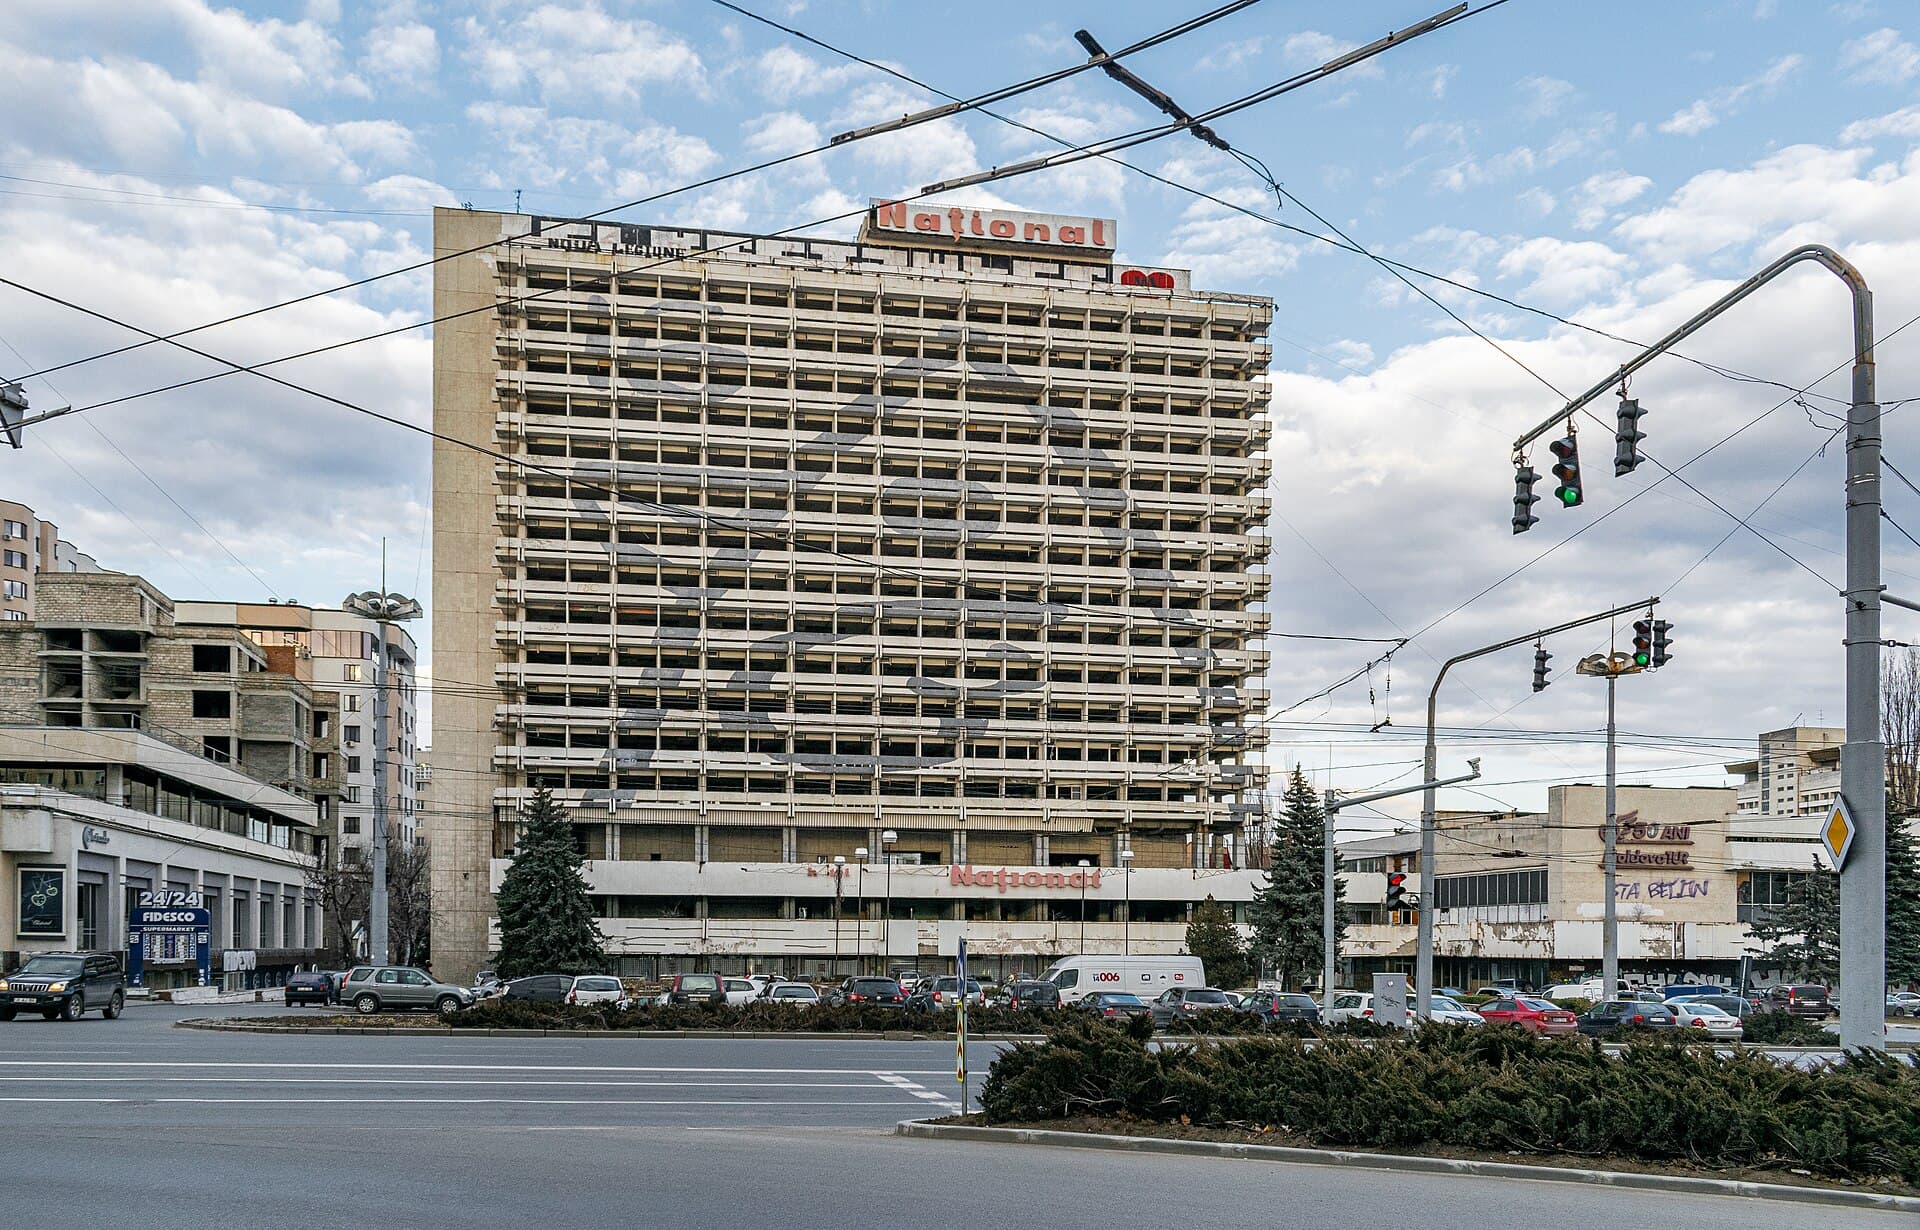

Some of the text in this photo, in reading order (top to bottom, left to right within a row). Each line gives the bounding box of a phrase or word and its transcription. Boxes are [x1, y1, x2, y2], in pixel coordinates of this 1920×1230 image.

[1660, 826, 1691, 840] ANI
[140, 891, 199, 906] 24/24
[143, 912, 196, 922] FIDESCO
[1100, 972, 1120, 982] 006
